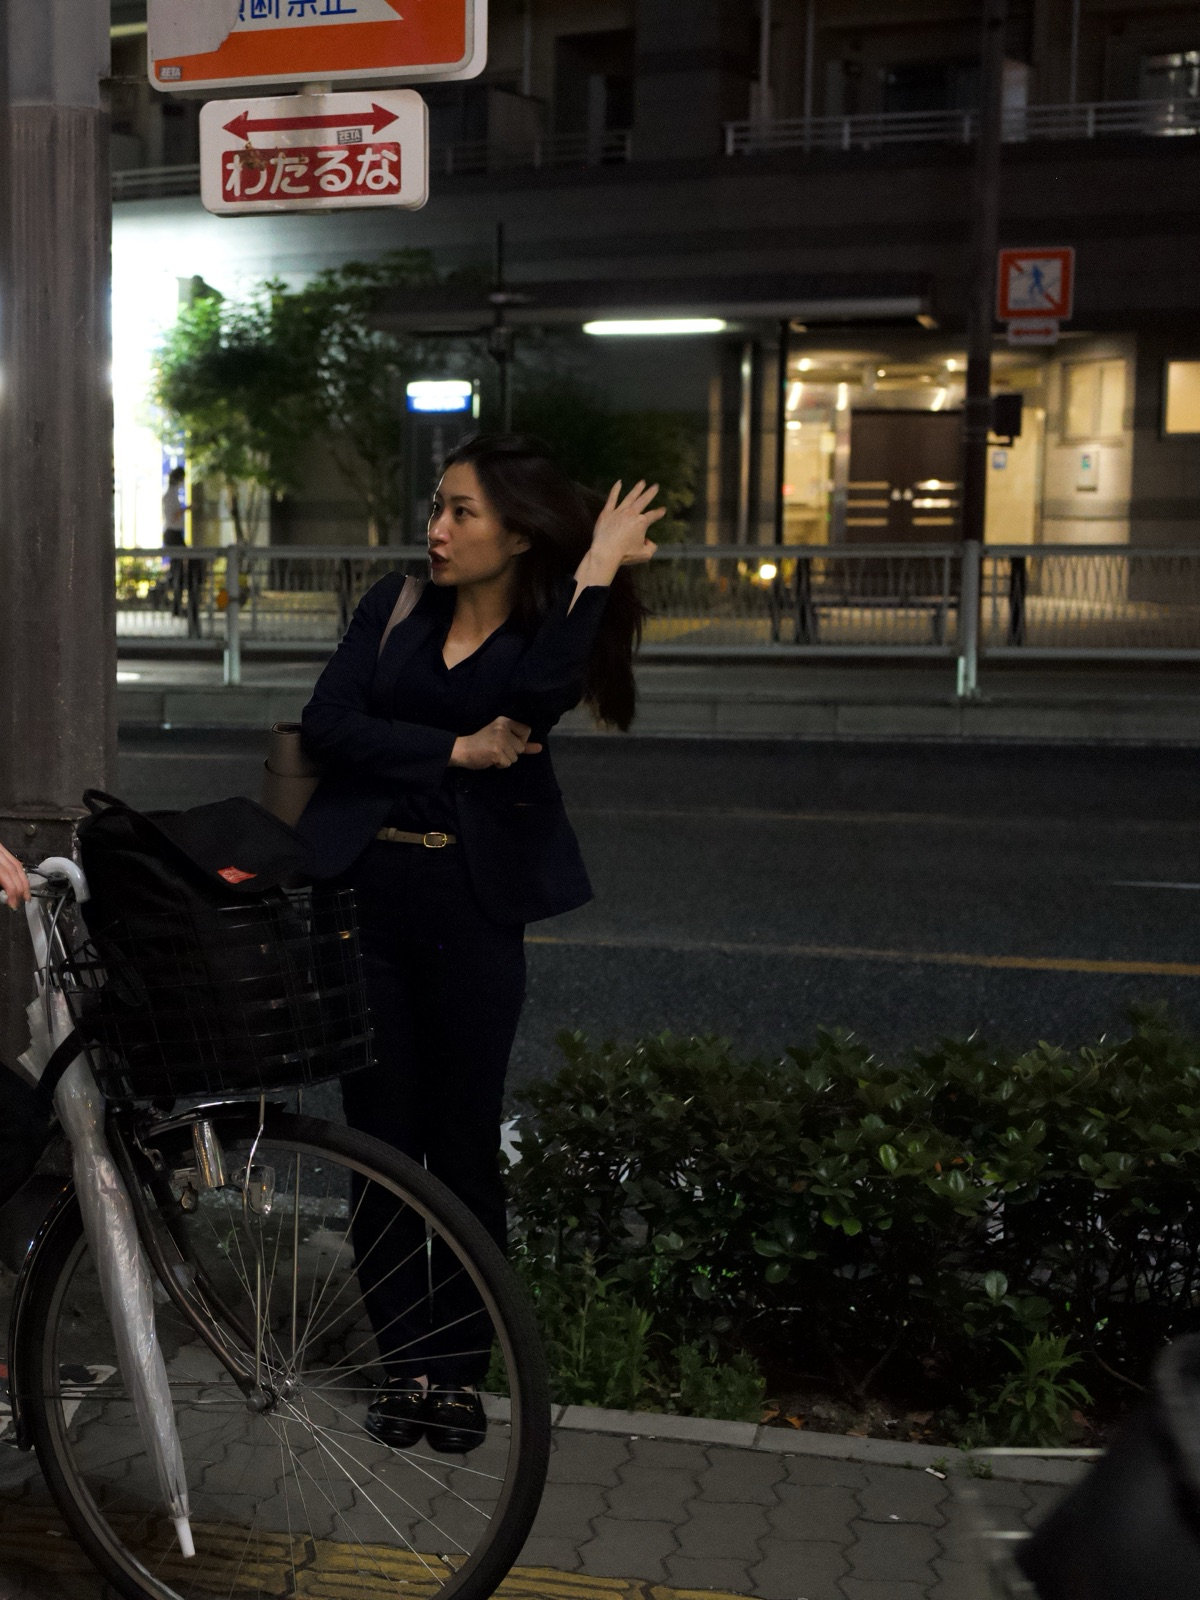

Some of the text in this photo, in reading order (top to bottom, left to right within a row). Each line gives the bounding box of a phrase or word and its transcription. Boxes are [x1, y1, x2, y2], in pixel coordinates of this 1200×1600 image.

[338, 129, 361, 141] ZETA
[225, 148, 399, 196] わたるな
